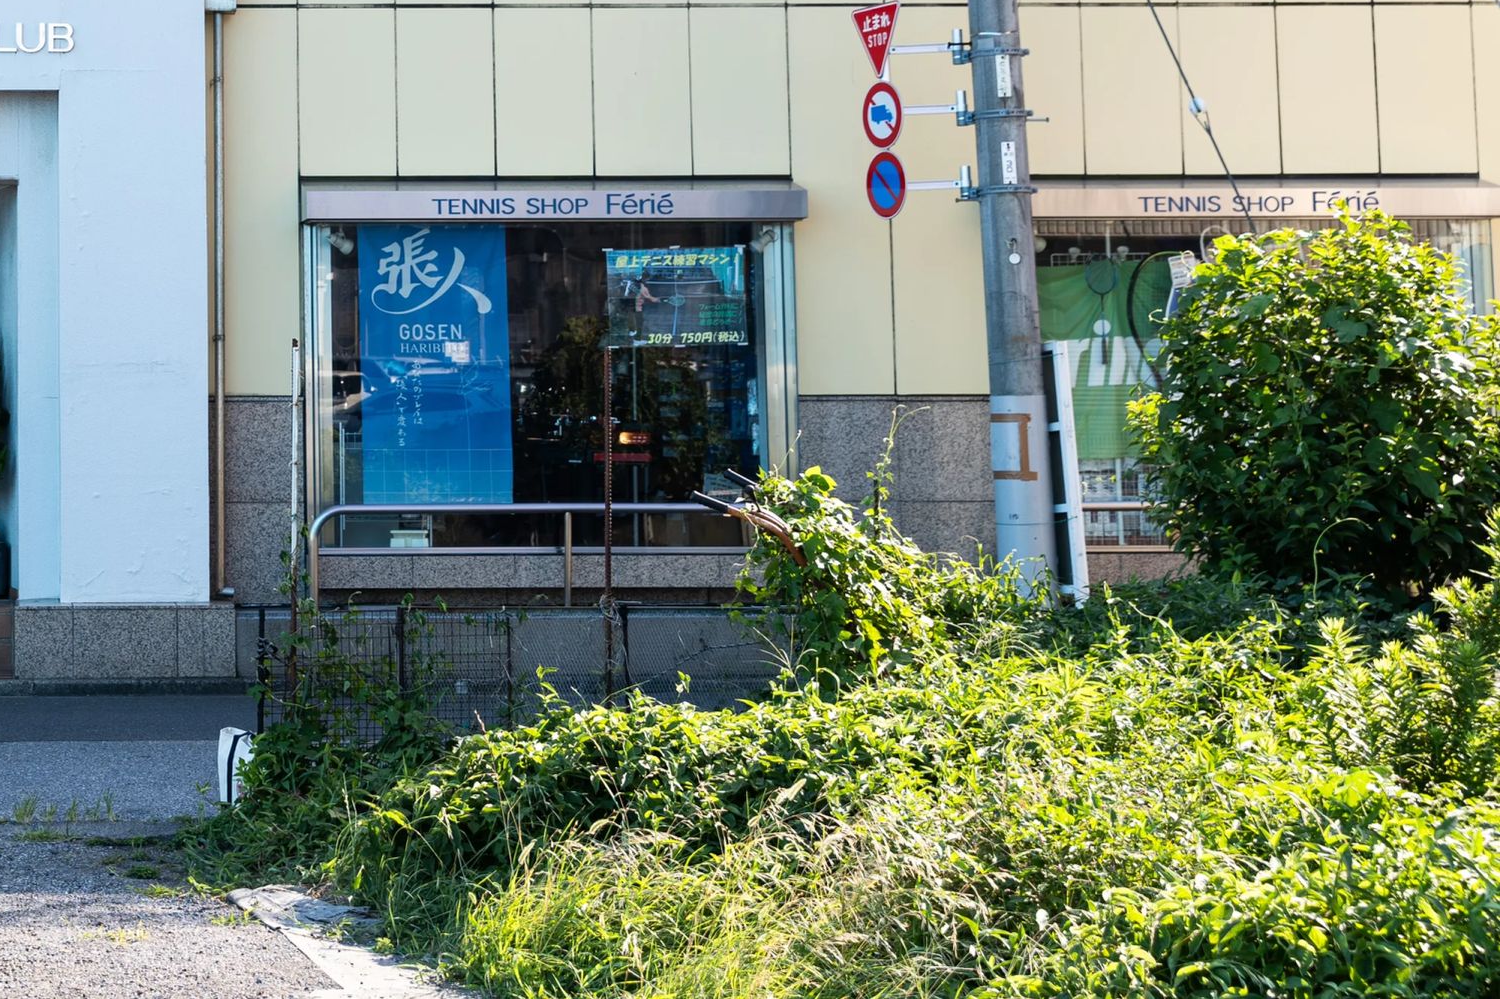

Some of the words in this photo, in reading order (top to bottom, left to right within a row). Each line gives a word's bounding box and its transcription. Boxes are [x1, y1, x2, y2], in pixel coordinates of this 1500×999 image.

[862, 11, 892, 33] 止まれ
[867, 31, 888, 48] STOP
[431, 197, 516, 215] TENNIS
[525, 197, 589, 215] SHOP
[606, 192, 675, 215] Férié
[1138, 195, 1221, 213] TENNIS
[1232, 195, 1295, 213] SHOP
[371, 227, 493, 315] 張人
[399, 323, 463, 340] GOSEN
[647, 333, 673, 344] 30分
[680, 330, 746, 343] 750円(税込)
